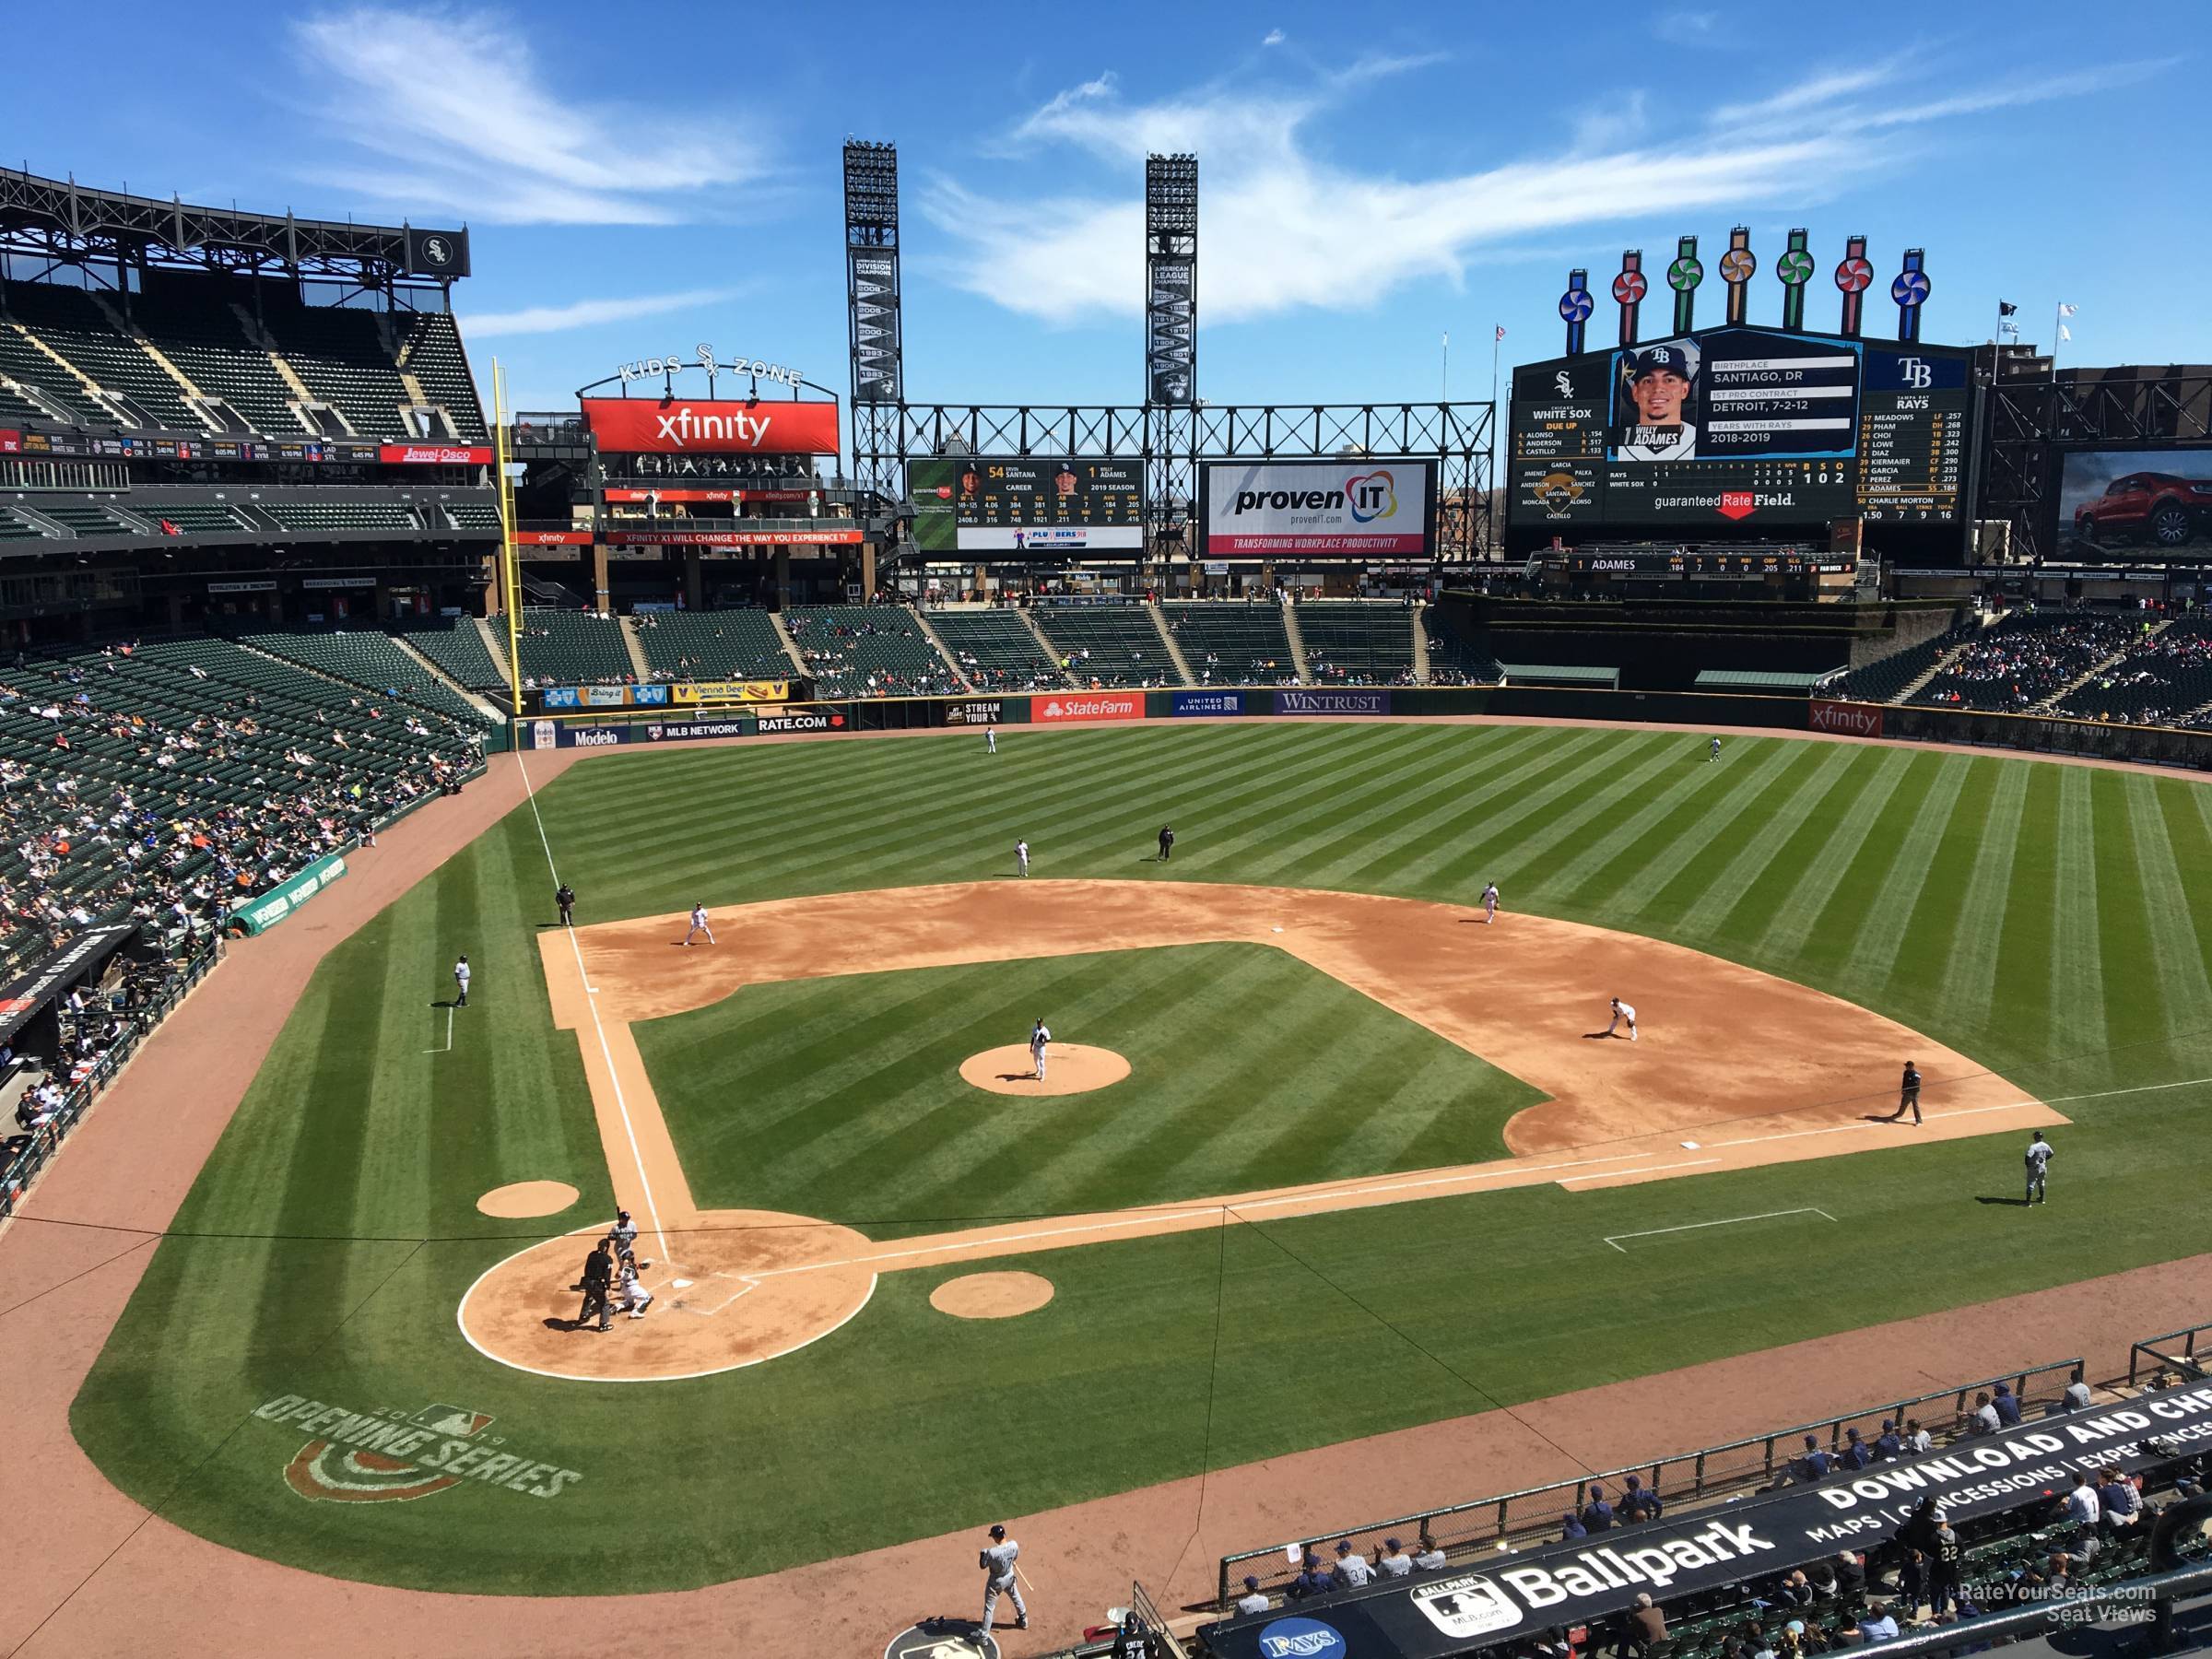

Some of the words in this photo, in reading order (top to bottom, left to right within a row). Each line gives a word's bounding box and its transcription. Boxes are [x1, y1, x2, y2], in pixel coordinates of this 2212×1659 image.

[1714, 361, 1769, 370] BIRTHPLACE
[618, 356, 682, 383] KIDS
[732, 357, 803, 389] ZONE
[1714, 372, 1783, 383] SANTIAGO,
[1785, 371, 1803, 382] DR
[1712, 392, 1726, 400] 1ST
[1729, 391, 1747, 399] PRO
[1749, 389, 1798, 398] CONTRACT
[1712, 402, 1770, 413] DETROIT,
[1772, 400, 1808, 411] 7-2-12
[1897, 400, 1929, 409] RAYS
[1533, 410, 1567, 419] WHITE
[1569, 409, 1592, 418] SOX
[656, 408, 771, 447] xfinity
[1635, 426, 1658, 435] WILLY
[1742, 420, 1767, 429] WITH
[1768, 420, 1793, 429] RAYS
[1624, 427, 1631, 445] 1
[1633, 433, 1679, 445] ADAMES
[1711, 432, 1771, 444] 2018-2019
[403, 448, 471, 459] Jewel-Osco
[988, 466, 1004, 478] 54
[1804, 473, 1811, 484] 1
[1818, 473, 1828, 484] 0
[1835, 472, 1844, 484] 2
[1234, 490, 1345, 515] proven
[1359, 487, 1384, 509] IT
[1654, 494, 1722, 510] guaranteed
[1722, 494, 1751, 507] Rate
[1290, 514, 1342, 526] provenIT.com
[1864, 511, 1882, 520] 1.50
[1940, 511, 1952, 519] 16
[538, 533, 566, 544] xfinity
[695, 534, 734, 543] CHANGE
[735, 534, 751, 542] THE
[752, 534, 772, 542] WAY
[773, 534, 792, 542] YOU
[793, 533, 839, 542] EXPERIENCE
[1233, 537, 1292, 549] TRANSFORMING
[1294, 538, 1342, 549] WORKPLACE
[1342, 537, 1399, 548] PRODUCTIVITY
[1591, 559, 1635, 570] ADAMES
[1786, 564, 1803, 572] .211
[590, 688, 614, 699] Bring
[693, 686, 724, 695] Vienna
[726, 683, 747, 693] Beef
[965, 702, 1001, 713] STREAM
[759, 716, 828, 732] RATE.COM
[966, 713, 988, 723] YOUR
[1813, 705, 1877, 735] xfinity
[666, 726, 688, 737] MLB
[690, 724, 739, 735] NETWORK
[575, 731, 618, 747] Modelo
[250, 1394, 437, 1456] OPENING
[417, 1440, 584, 1499] SERIES
[1818, 1434, 2065, 1510] DOWNLOAD
[2065, 1411, 2151, 1444] AND
[1805, 1515, 1882, 1543] MAPS
[1898, 1465, 2066, 1518] CNCESSIONS
[1940, 1547, 1959, 1562] 22
[1500, 1522, 1777, 1609] Ballpark
[1350, 1568, 1366, 1583] 33
[1418, 1575, 1478, 1598] BALLPARK
[1126, 1641, 1145, 1650] CREDE
